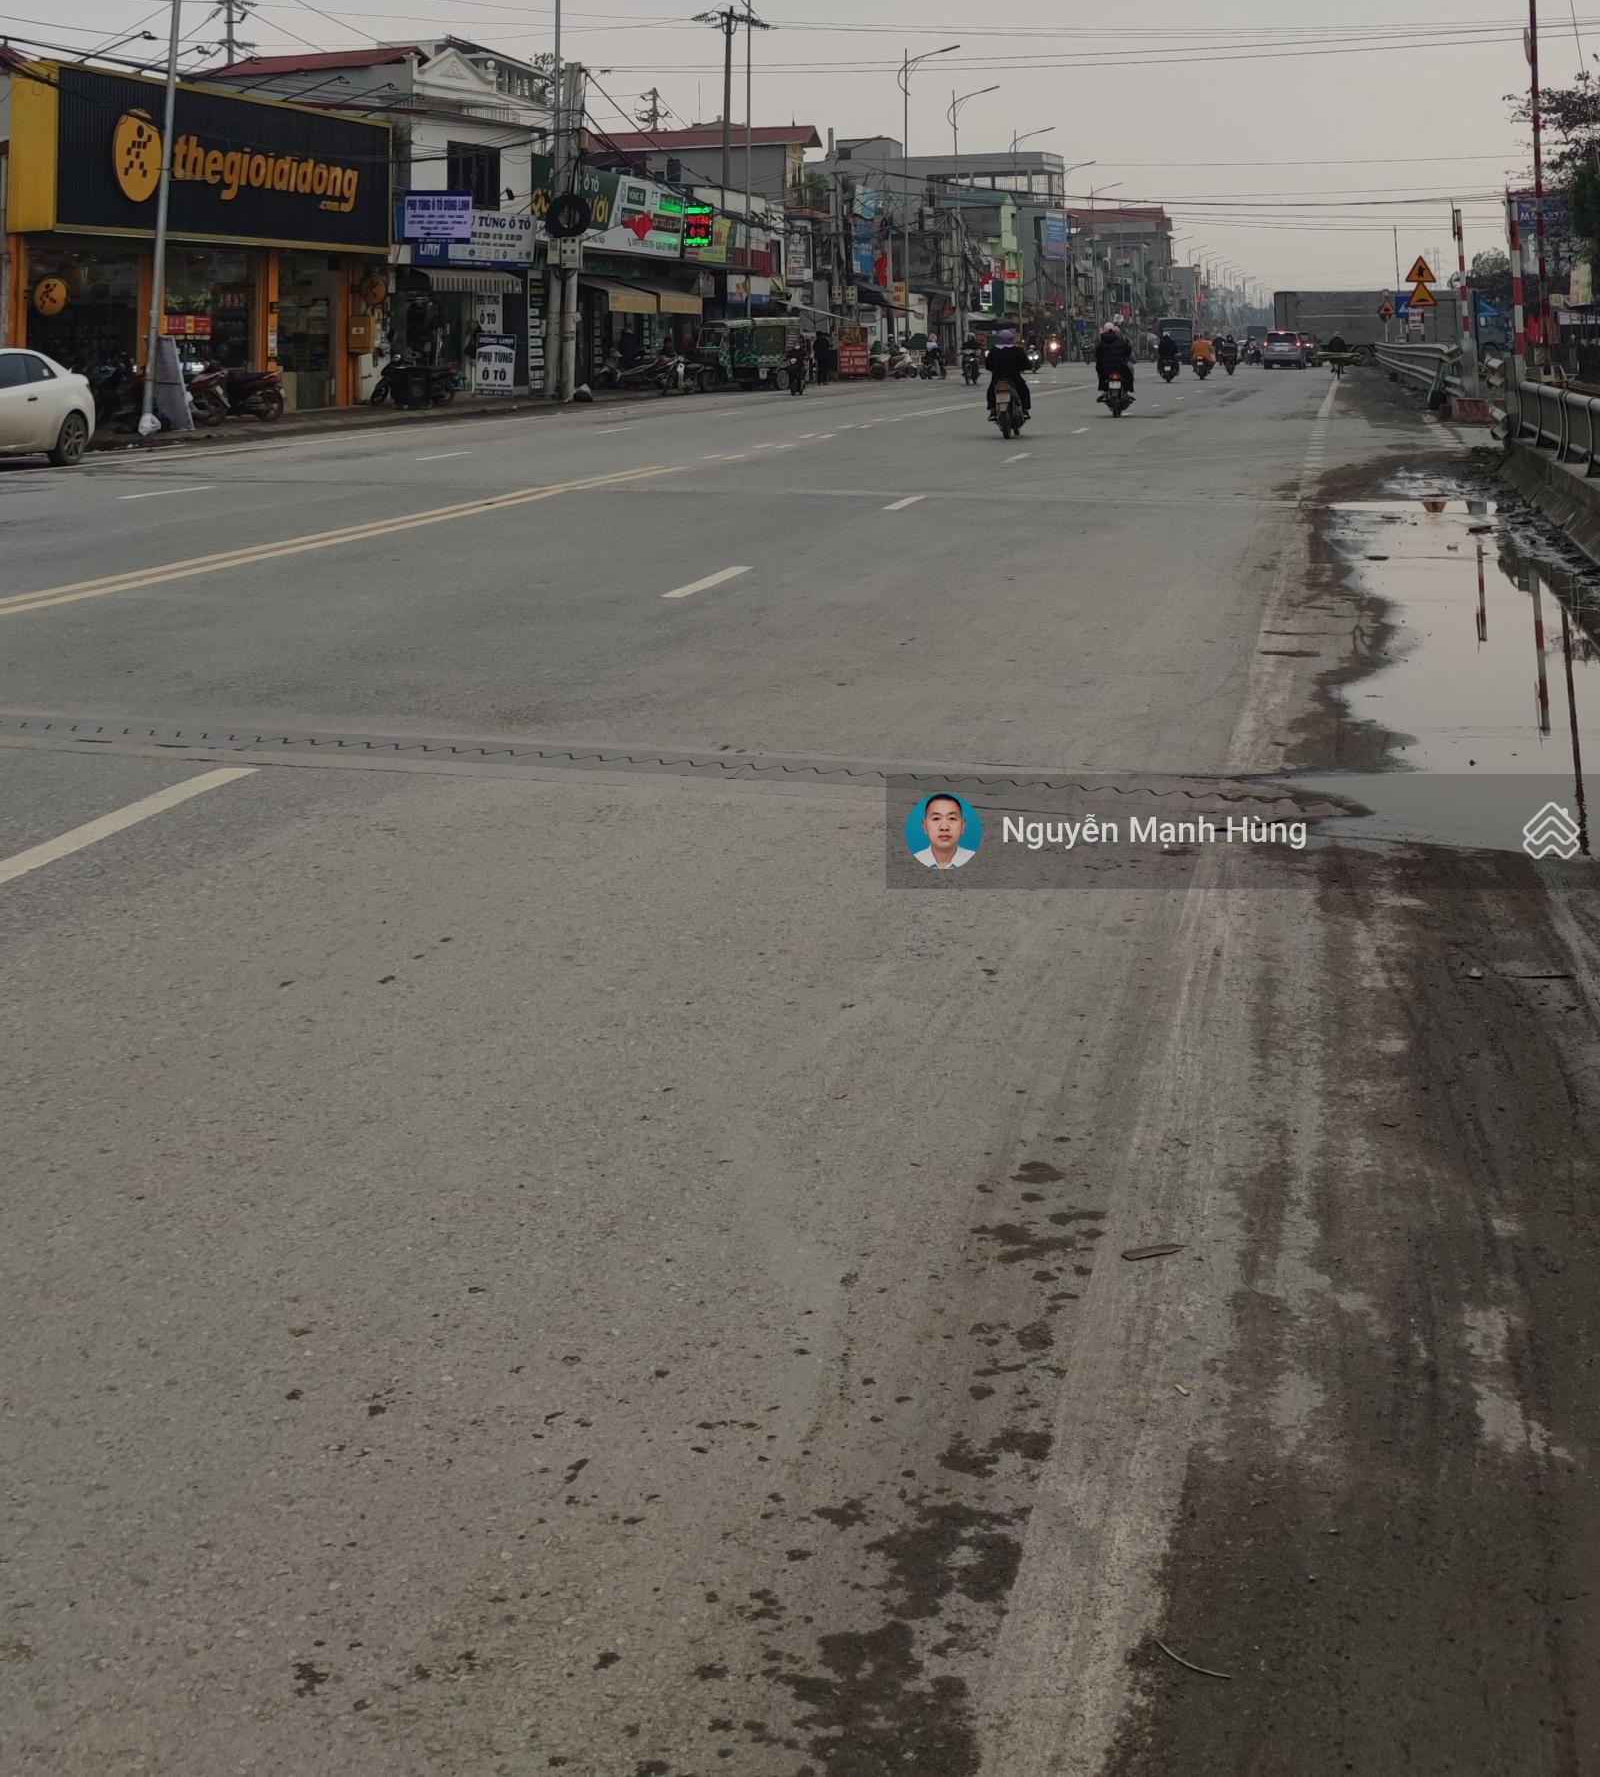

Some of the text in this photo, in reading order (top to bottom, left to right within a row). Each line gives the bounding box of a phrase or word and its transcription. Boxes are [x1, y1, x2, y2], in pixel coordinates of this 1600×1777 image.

[173, 133, 359, 213] thegioididong
[478, 214, 506, 228] TÙNG
[518, 217, 531, 230] TÔ
[477, 349, 513, 365] PHỤ TÙNG
[482, 366, 507, 381] Ô TÔ
